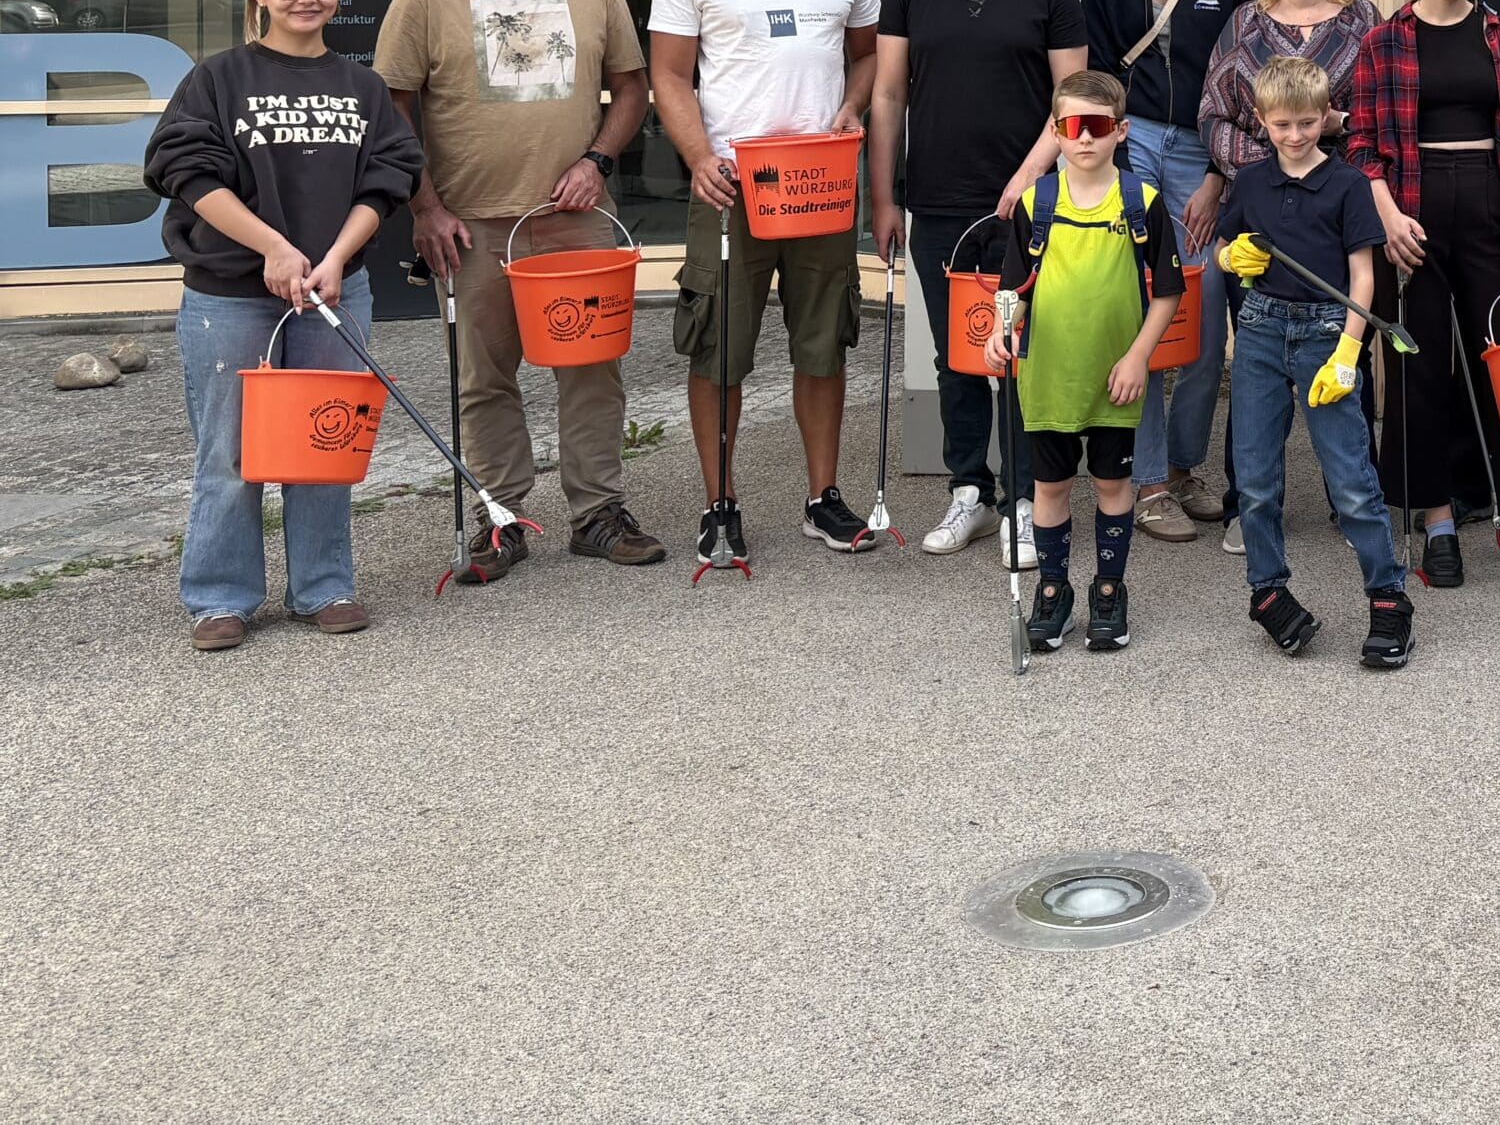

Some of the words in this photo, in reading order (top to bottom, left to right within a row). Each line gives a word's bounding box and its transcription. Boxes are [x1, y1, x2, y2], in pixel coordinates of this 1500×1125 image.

[770, 13, 792, 25] IHK
[246, 95, 289, 111] I'M
[293, 95, 359, 111] JUST
[234, 118, 250, 136] A
[254, 110, 308, 127] KID
[248, 130, 267, 148] A
[272, 127, 362, 147] DREAM
[784, 167, 828, 182] STADT
[785, 179, 853, 196] WÜRZBURG
[759, 204, 776, 216] Die
[780, 197, 852, 215] Stadtreiniger
